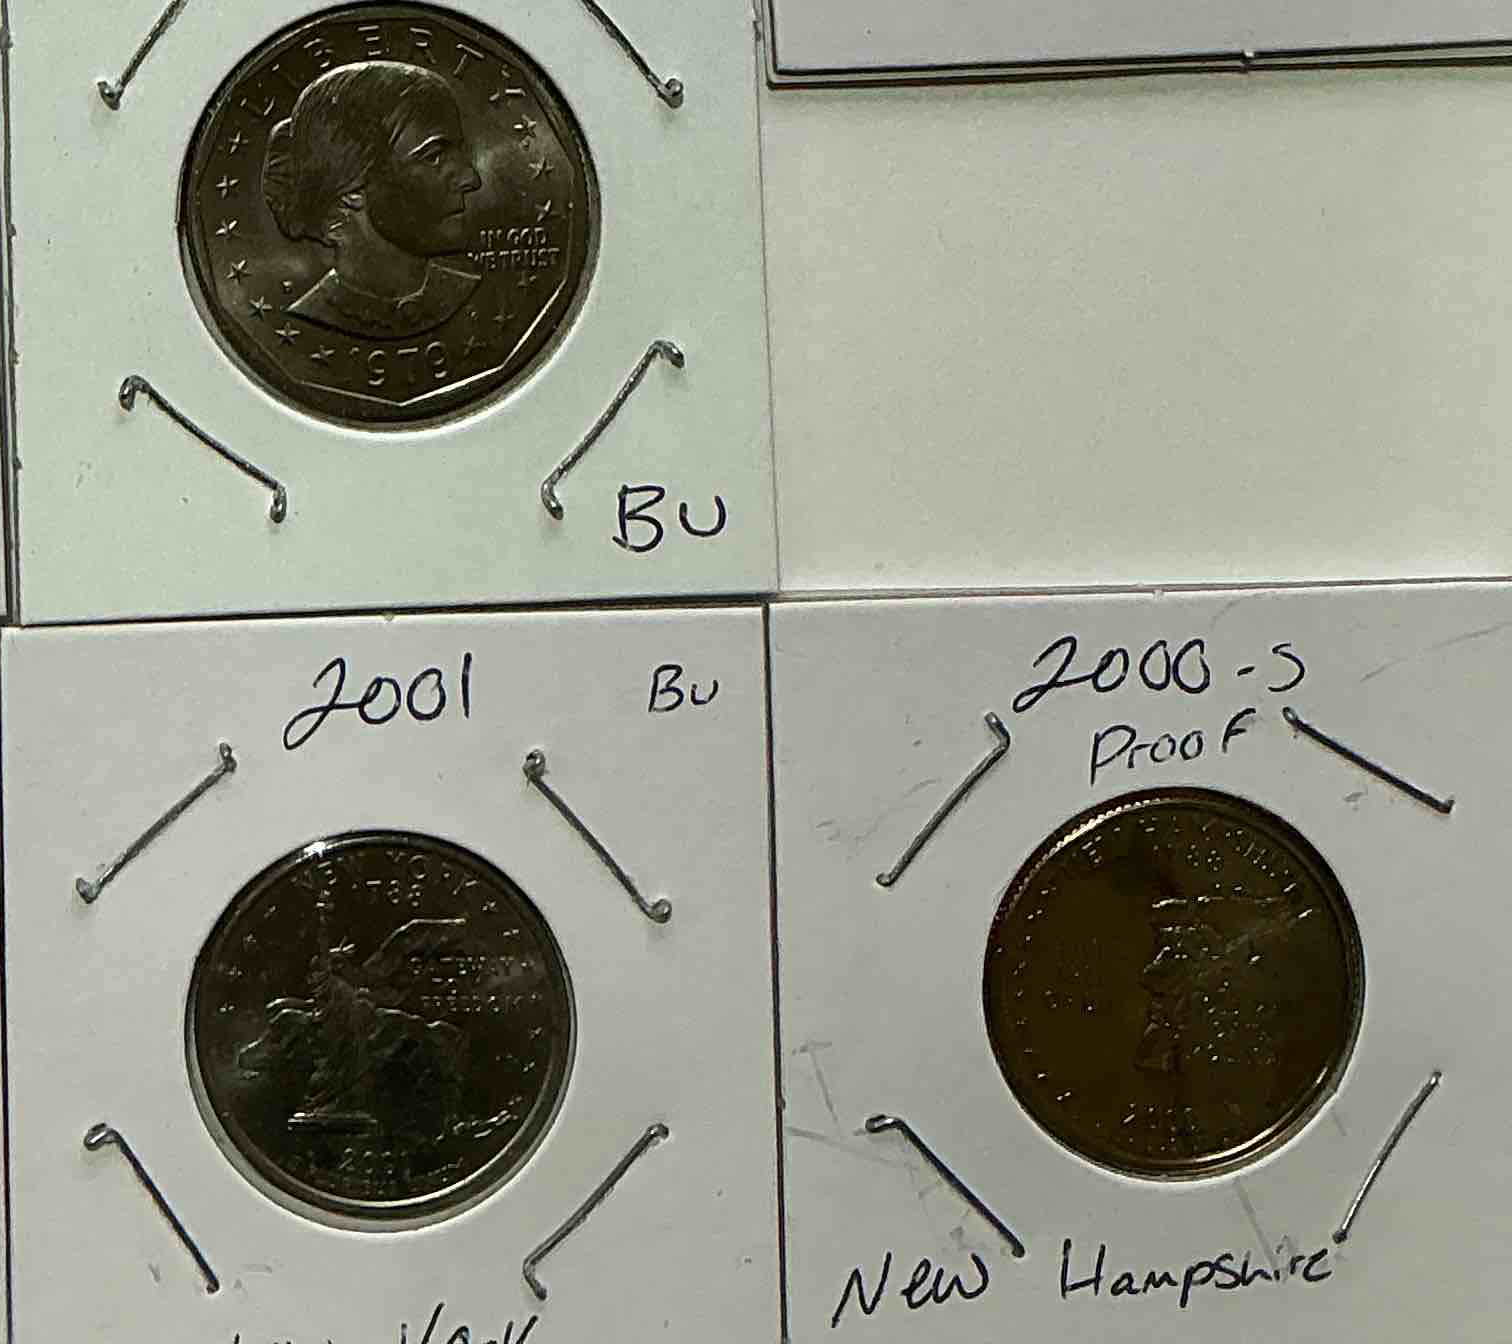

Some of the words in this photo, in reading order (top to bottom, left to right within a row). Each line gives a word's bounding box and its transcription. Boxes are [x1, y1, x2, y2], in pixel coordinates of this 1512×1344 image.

[507, 226, 548, 246] GOD
[348, 338, 450, 388] 1979
[282, 652, 474, 752] 2001
[831, 1251, 990, 1330] New
[1059, 1238, 1336, 1309] Hampshire
